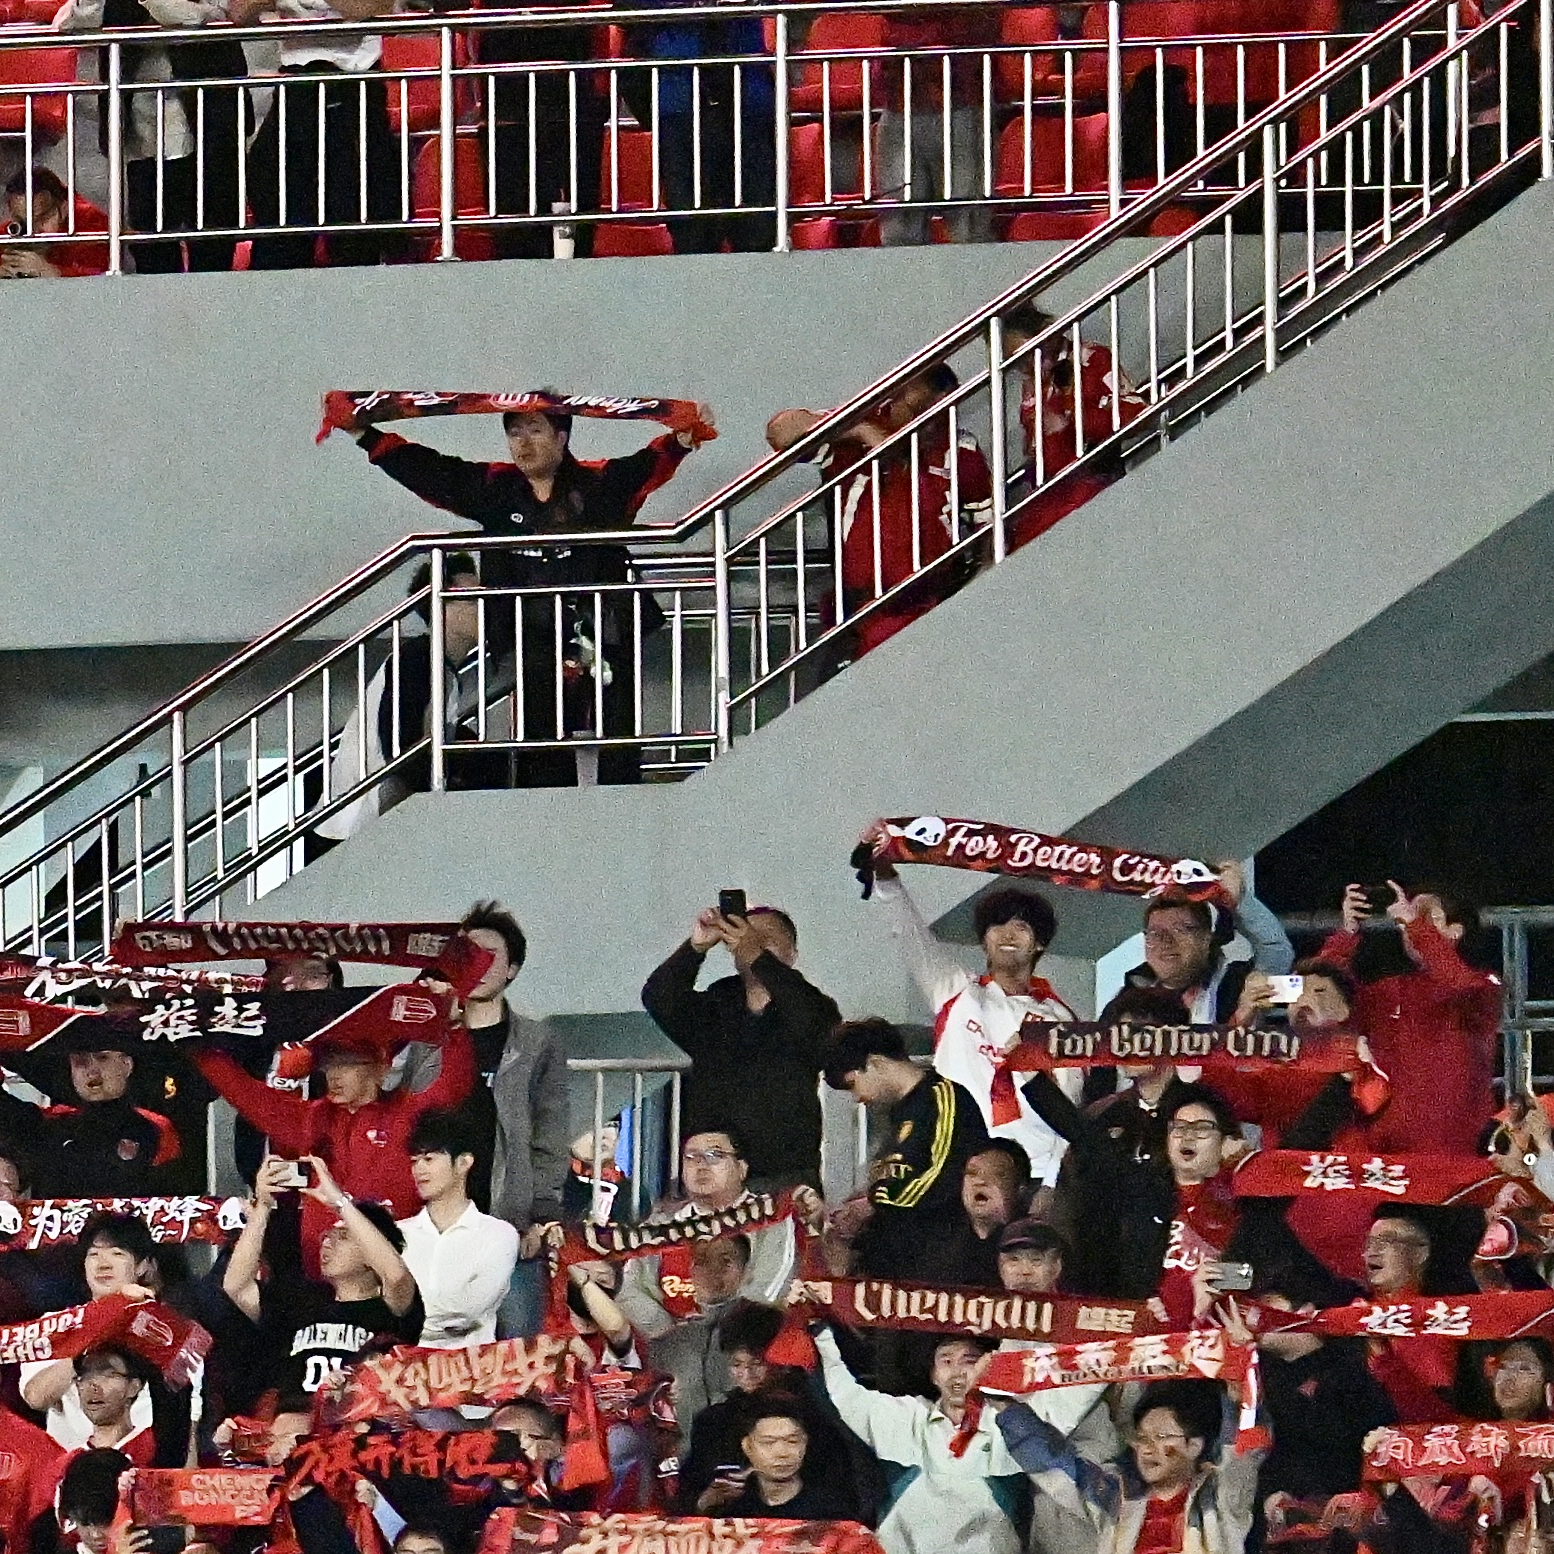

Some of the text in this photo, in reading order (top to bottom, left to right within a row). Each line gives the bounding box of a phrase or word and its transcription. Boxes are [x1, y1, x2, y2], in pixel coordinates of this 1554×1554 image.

[946, 823, 1175, 897] For Better City
